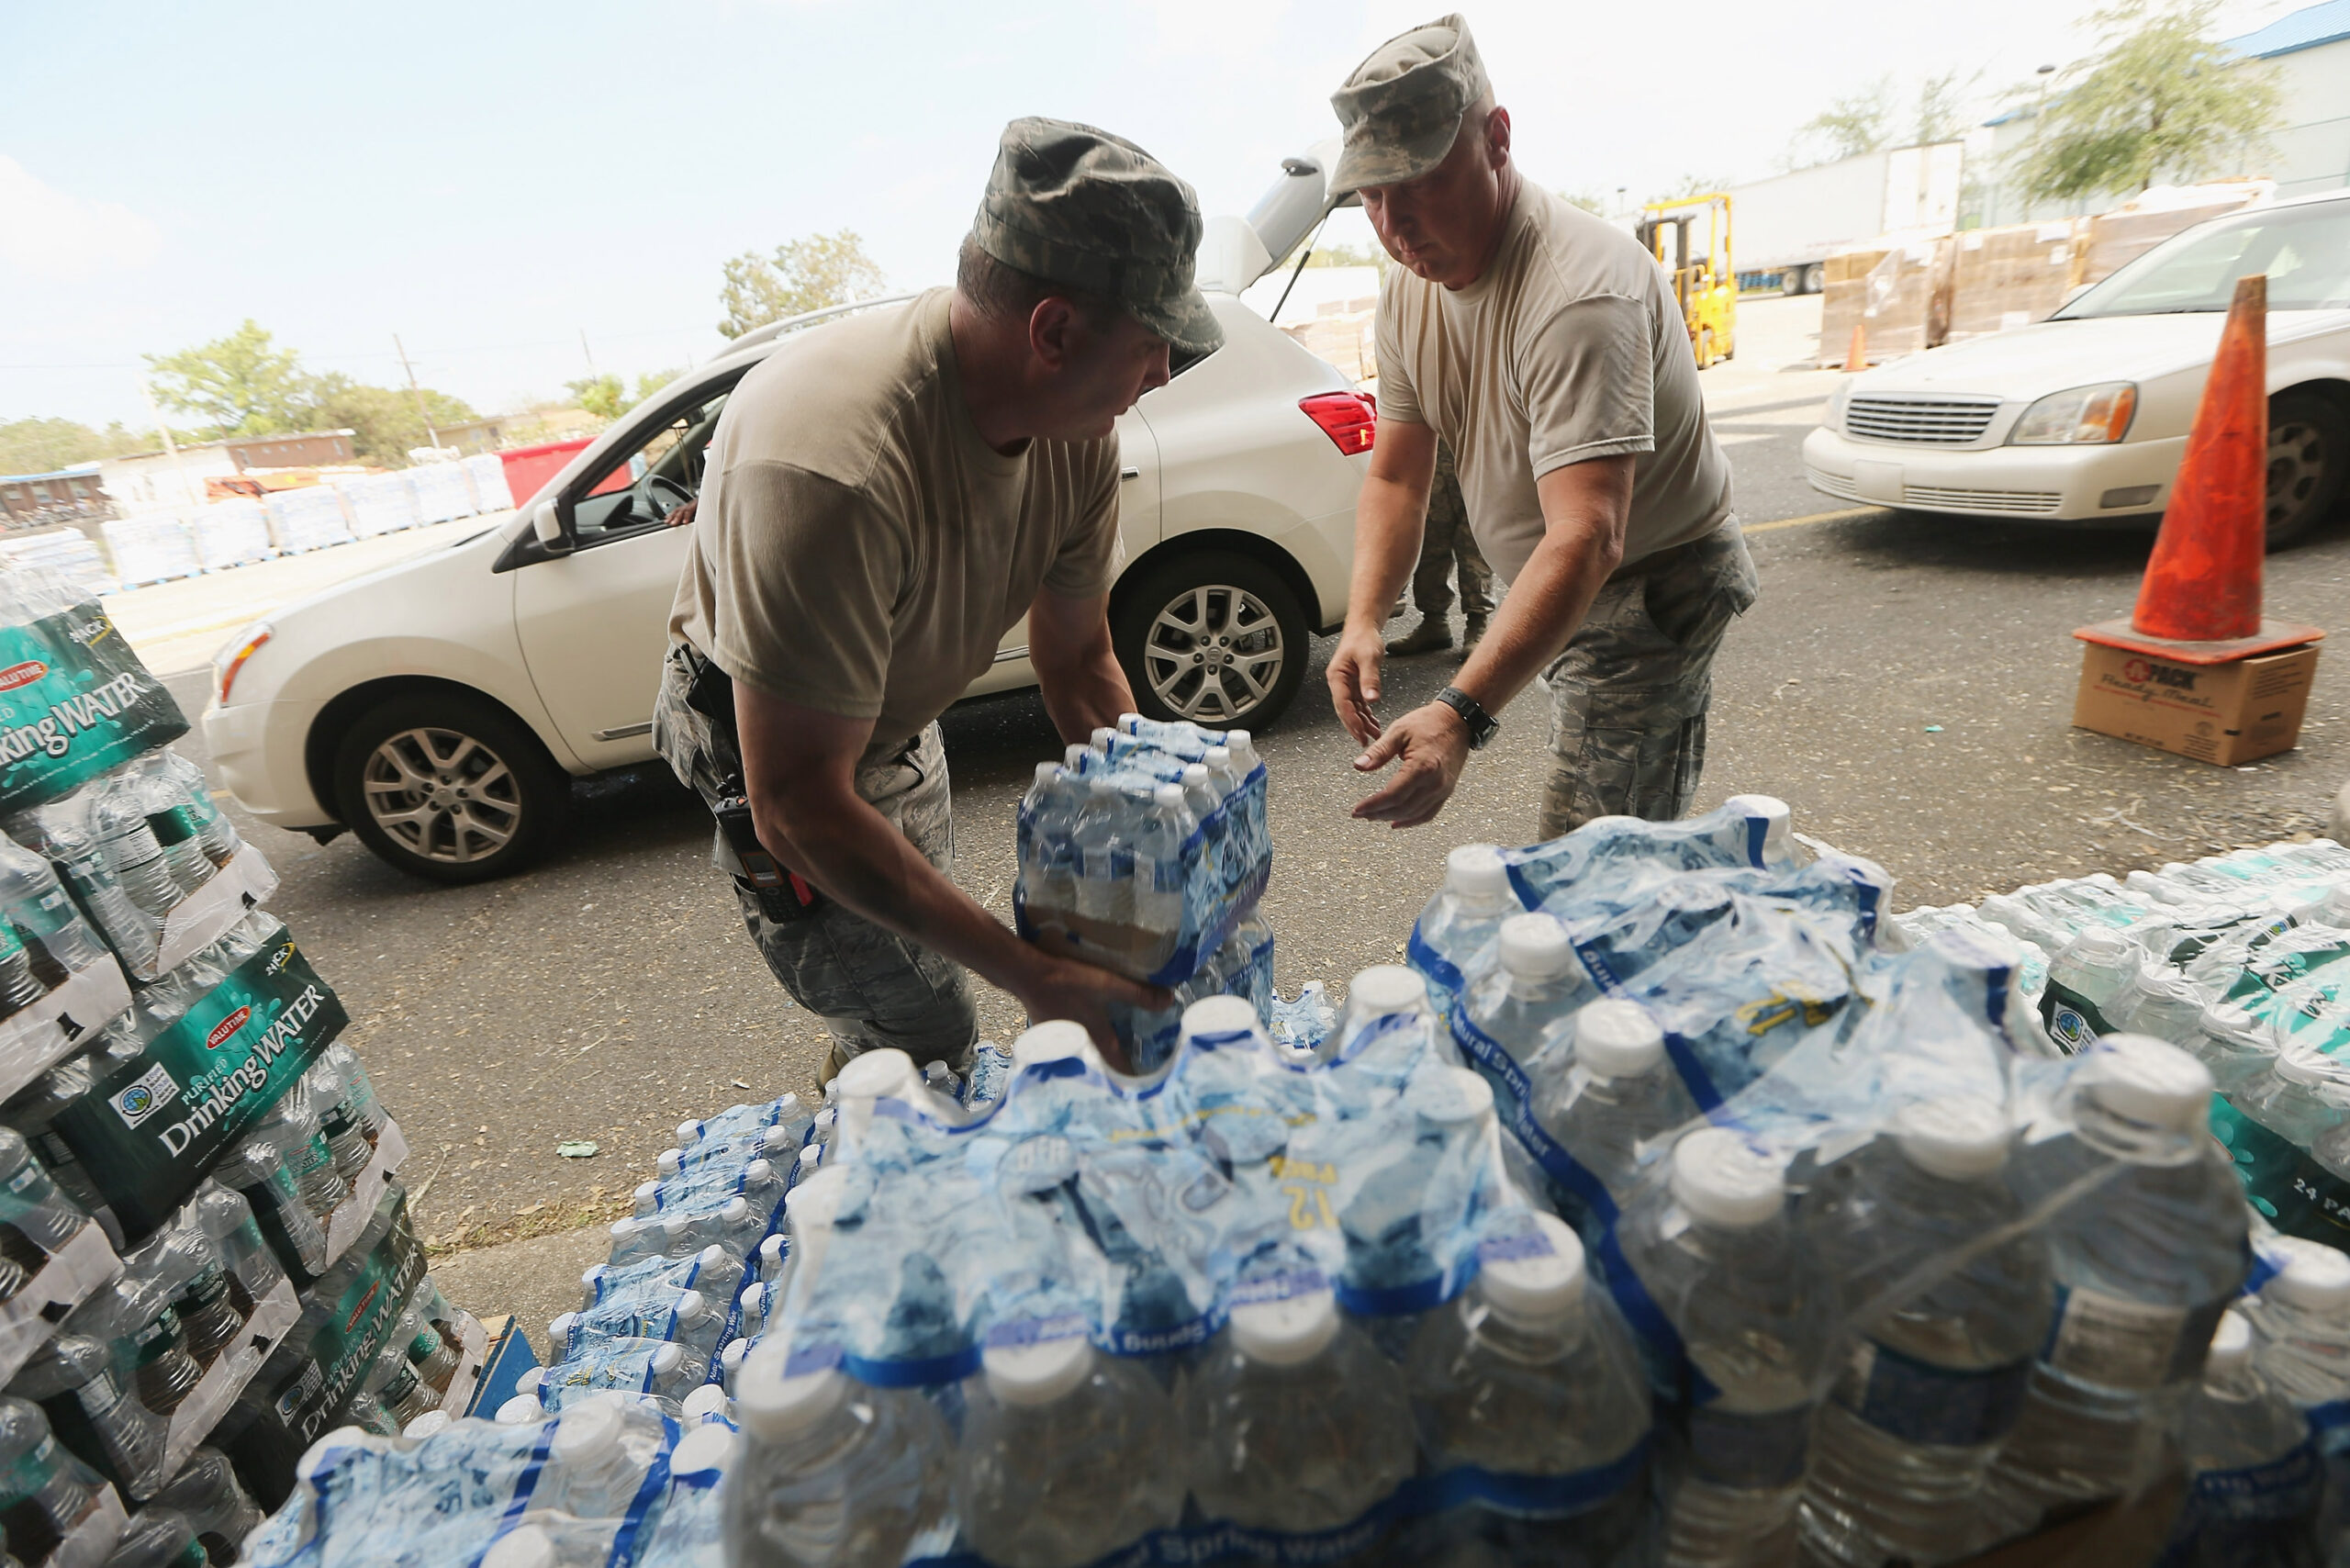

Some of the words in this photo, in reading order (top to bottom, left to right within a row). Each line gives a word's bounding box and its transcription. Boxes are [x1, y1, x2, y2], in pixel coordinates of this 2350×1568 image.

[50, 672, 151, 738] WATER
[209, 1010, 248, 1045] VALUTIME
[158, 1055, 268, 1159] Drinking
[252, 984, 326, 1067] WATER
[182, 1057, 229, 1105] PURIFIED
[2294, 1178, 2316, 1201] 24
[301, 1327, 381, 1444] Drinking
[371, 1243, 419, 1331] WATER
[713, 1323, 735, 1361] Spring
